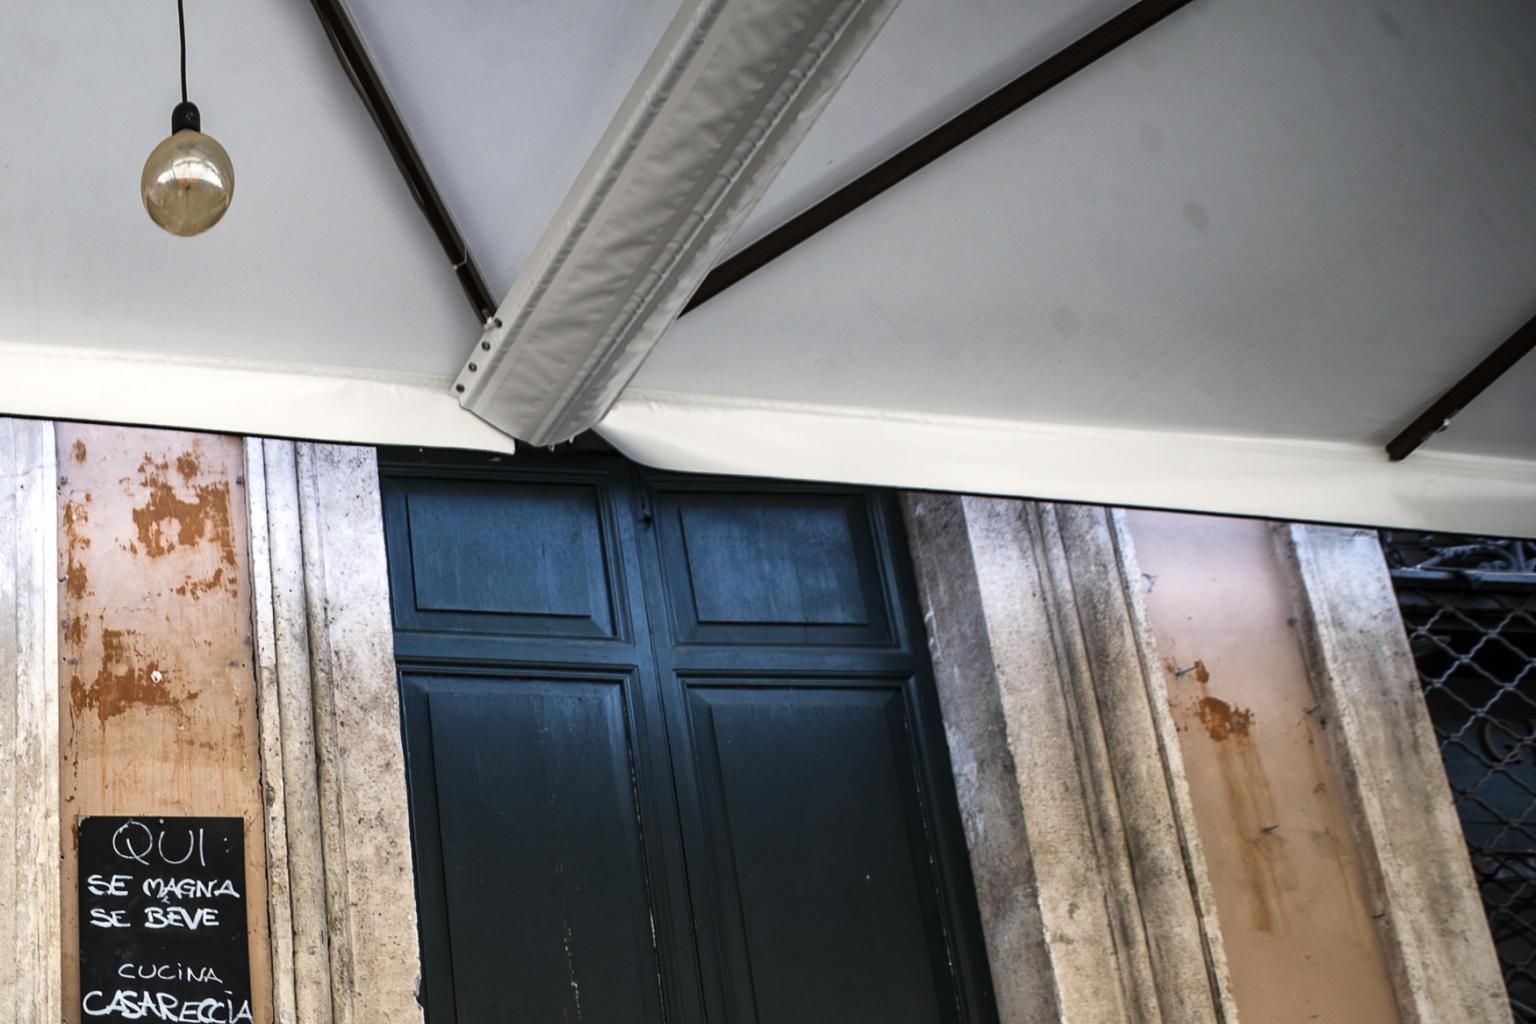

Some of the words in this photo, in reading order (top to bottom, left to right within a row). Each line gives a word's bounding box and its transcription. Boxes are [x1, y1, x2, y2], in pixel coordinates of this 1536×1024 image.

[112, 821, 206, 867] QUI
[87, 875, 134, 897] SE
[142, 878, 240, 899] MAGNA
[90, 907, 131, 929] SE
[144, 906, 220, 930] BEVE
[82, 990, 254, 1024] CASARECCIA
